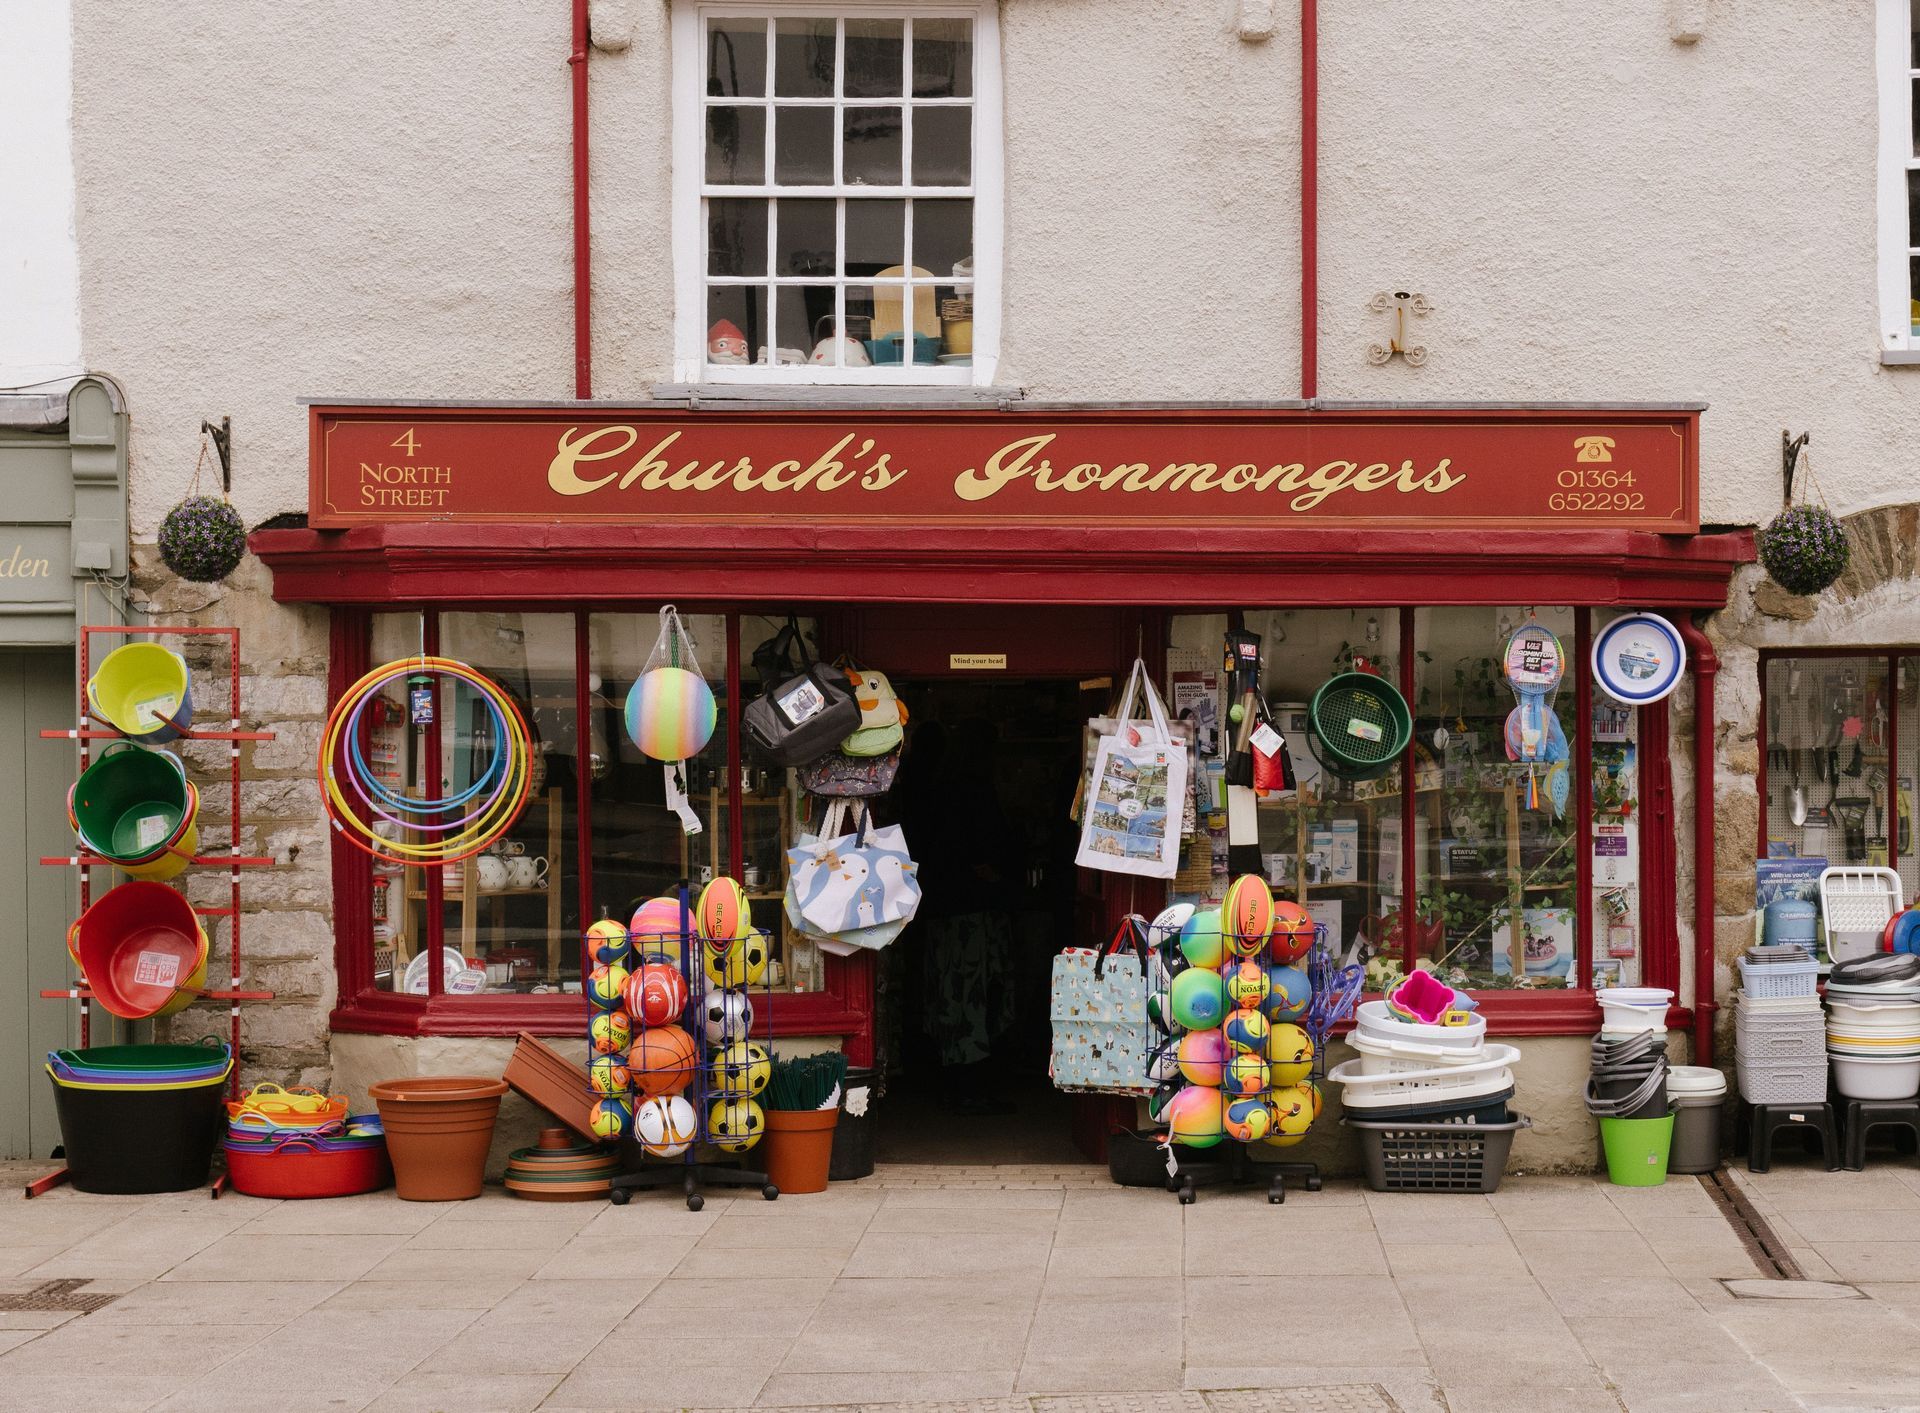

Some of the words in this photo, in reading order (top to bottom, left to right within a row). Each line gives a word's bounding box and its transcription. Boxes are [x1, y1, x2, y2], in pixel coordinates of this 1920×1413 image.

[390, 427, 421, 457] 4
[359, 462, 451, 484] NORTH
[547, 425, 909, 497] Church's
[953, 433, 1467, 513] Ironmongers
[1557, 470, 1637, 488] 01364
[360, 485, 450, 506] STREET
[1548, 492, 1646, 511] 652292
[971, 658, 987, 666] your
[1606, 837, 1616, 845] 15
[715, 903, 723, 938] BEACH
[1247, 899, 1257, 935] BEACH
[602, 1025, 628, 1041] DEVON
